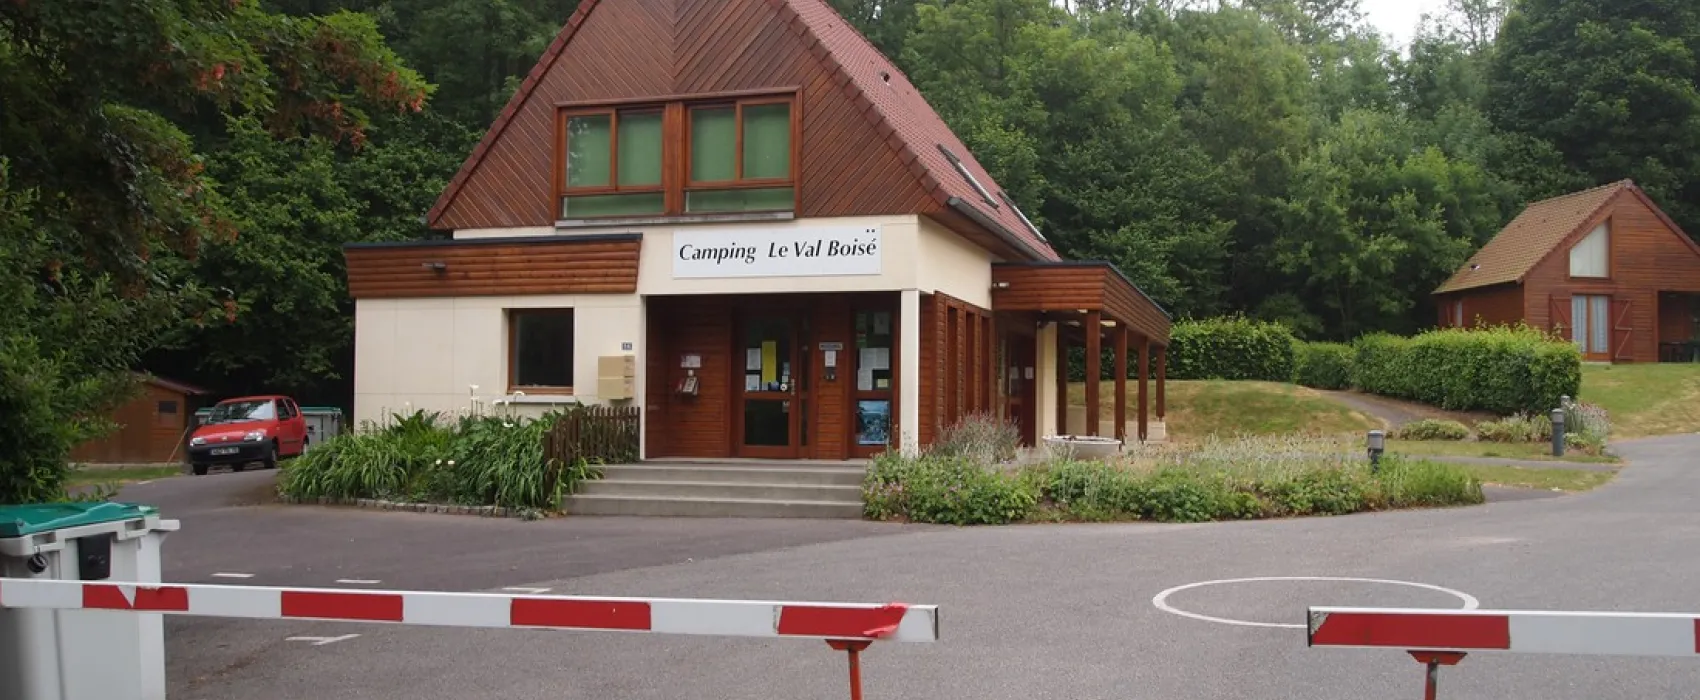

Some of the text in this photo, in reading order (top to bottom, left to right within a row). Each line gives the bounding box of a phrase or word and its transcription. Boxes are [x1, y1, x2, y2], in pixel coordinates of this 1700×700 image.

[679, 237, 877, 264] Camping Le Val Boisé
